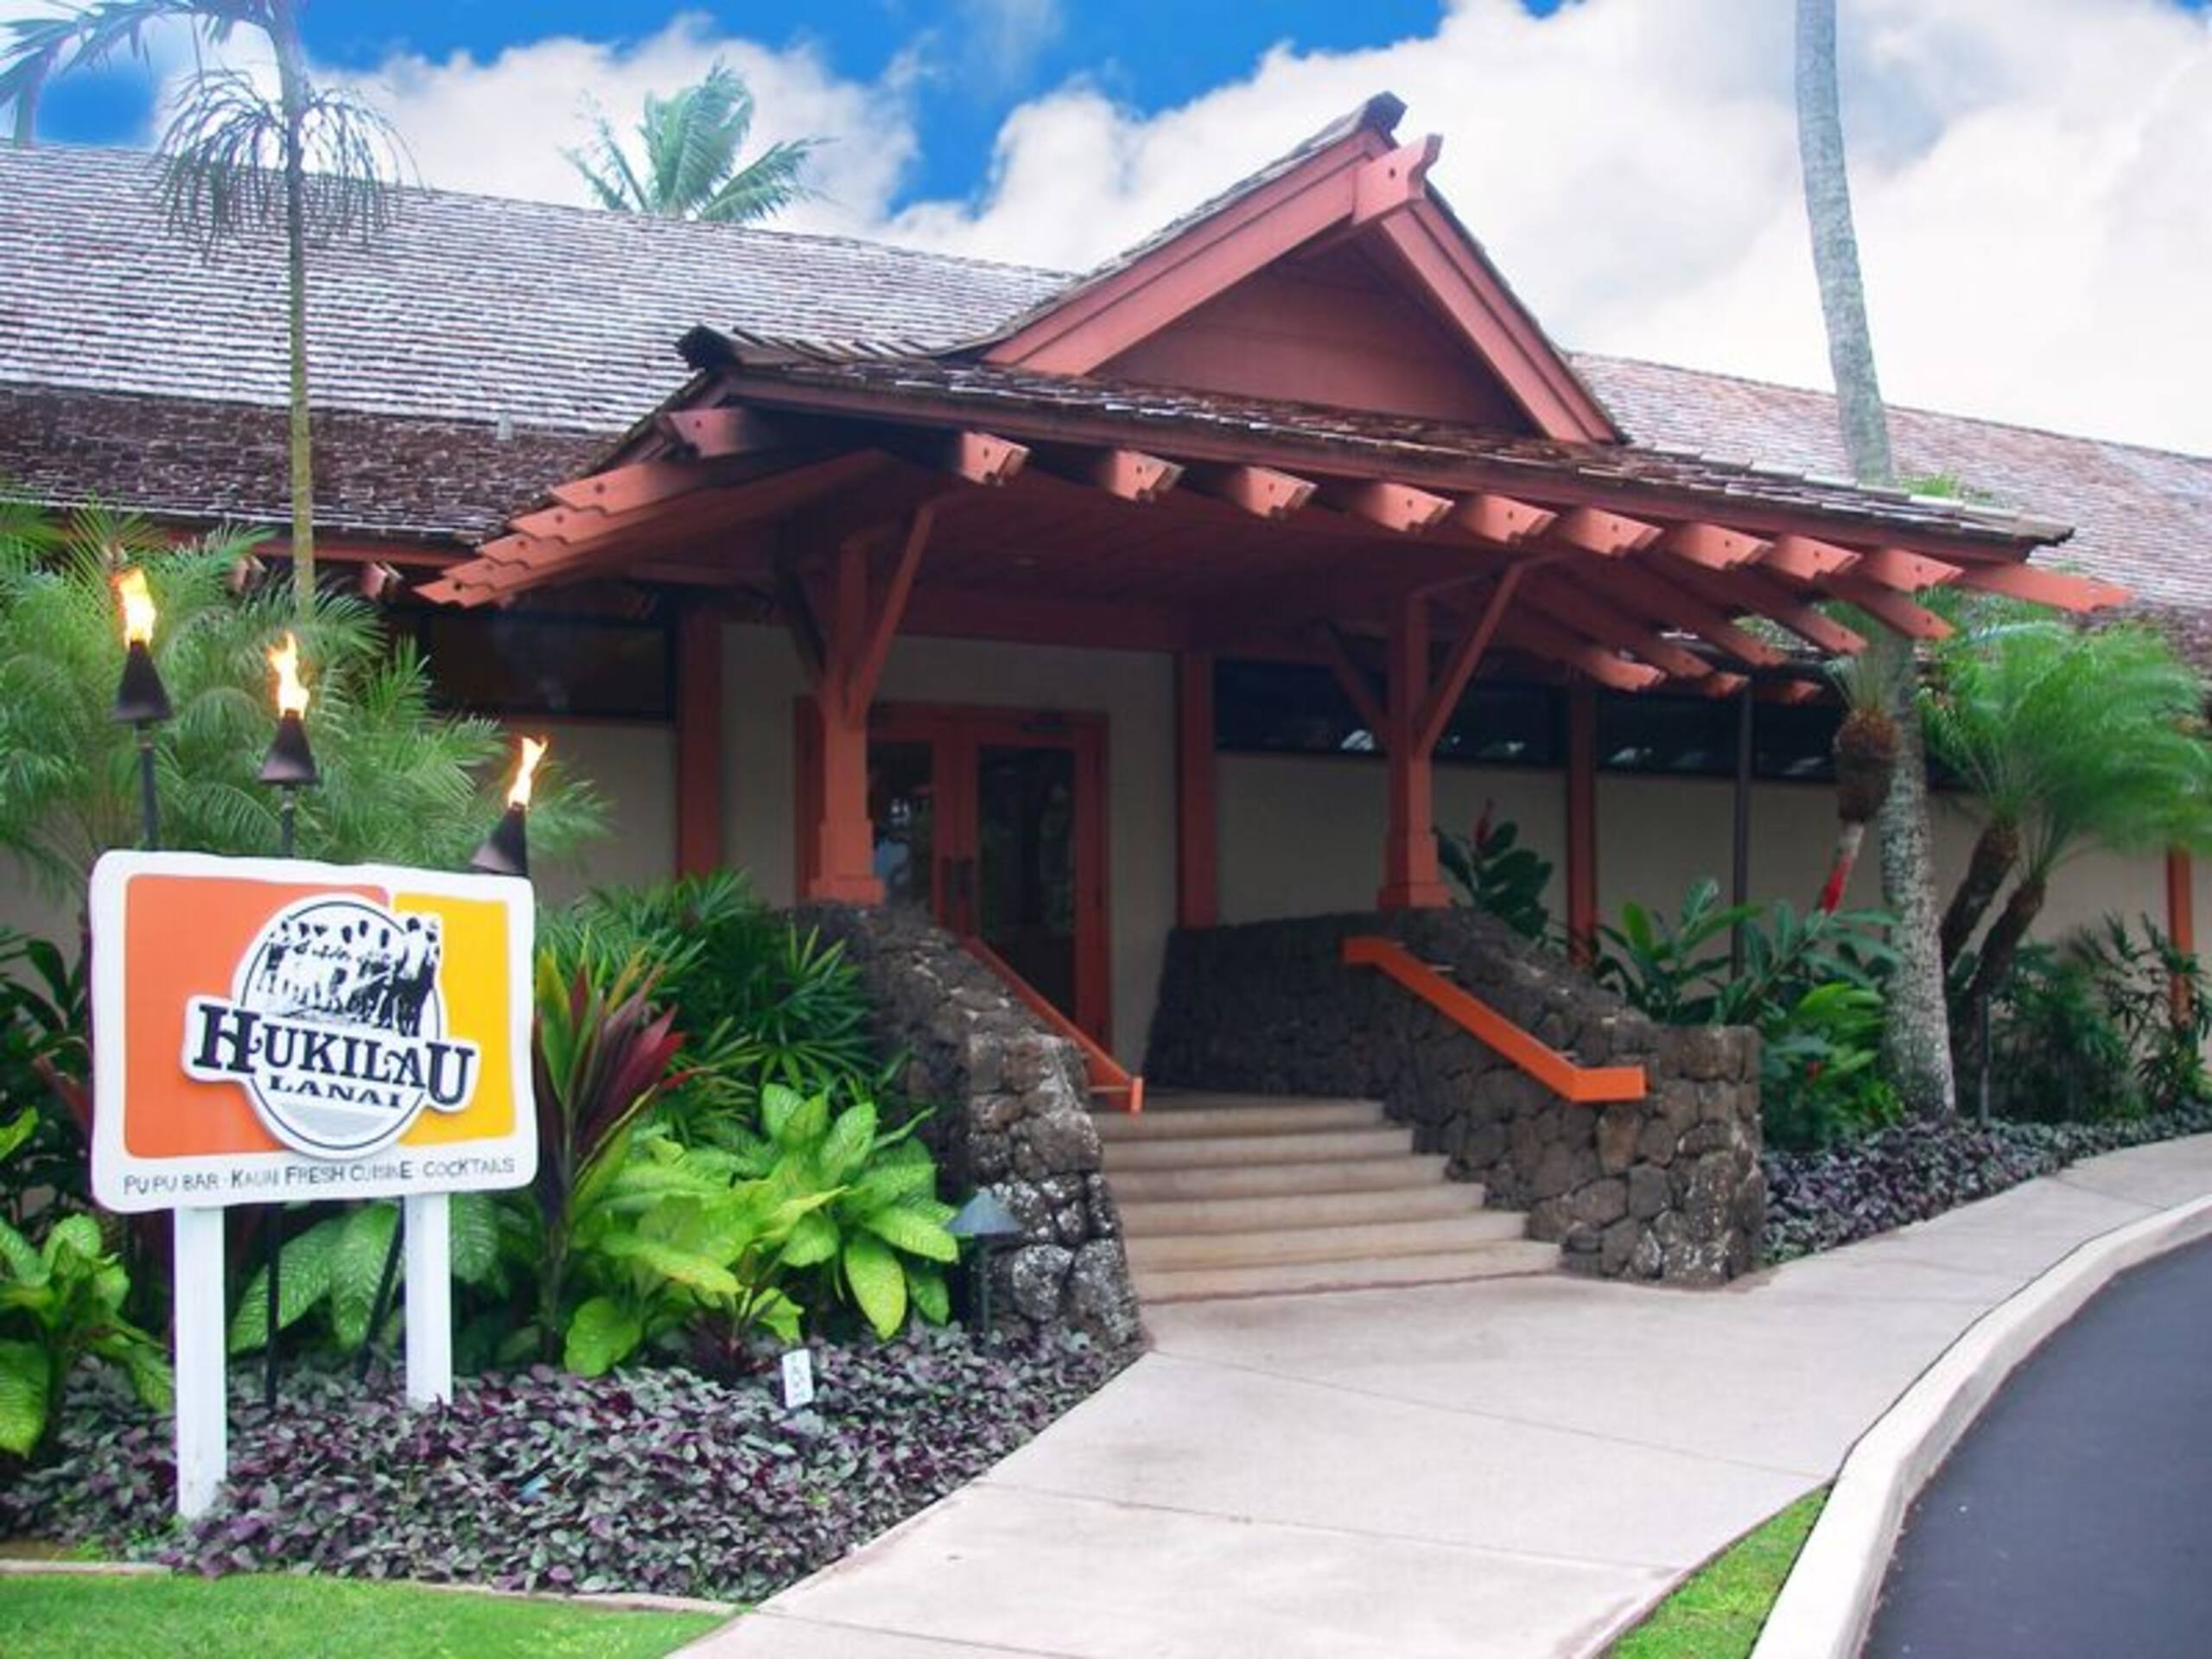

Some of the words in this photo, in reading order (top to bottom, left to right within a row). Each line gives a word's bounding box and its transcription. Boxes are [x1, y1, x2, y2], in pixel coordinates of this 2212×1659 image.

[193, 1003, 476, 1106] HUKILAU
[269, 1075, 402, 1108] LANAI
[182, 1173, 219, 1192] BAR
[285, 1164, 344, 1185] FRESH
[423, 1157, 515, 1177] COCKTAILS
